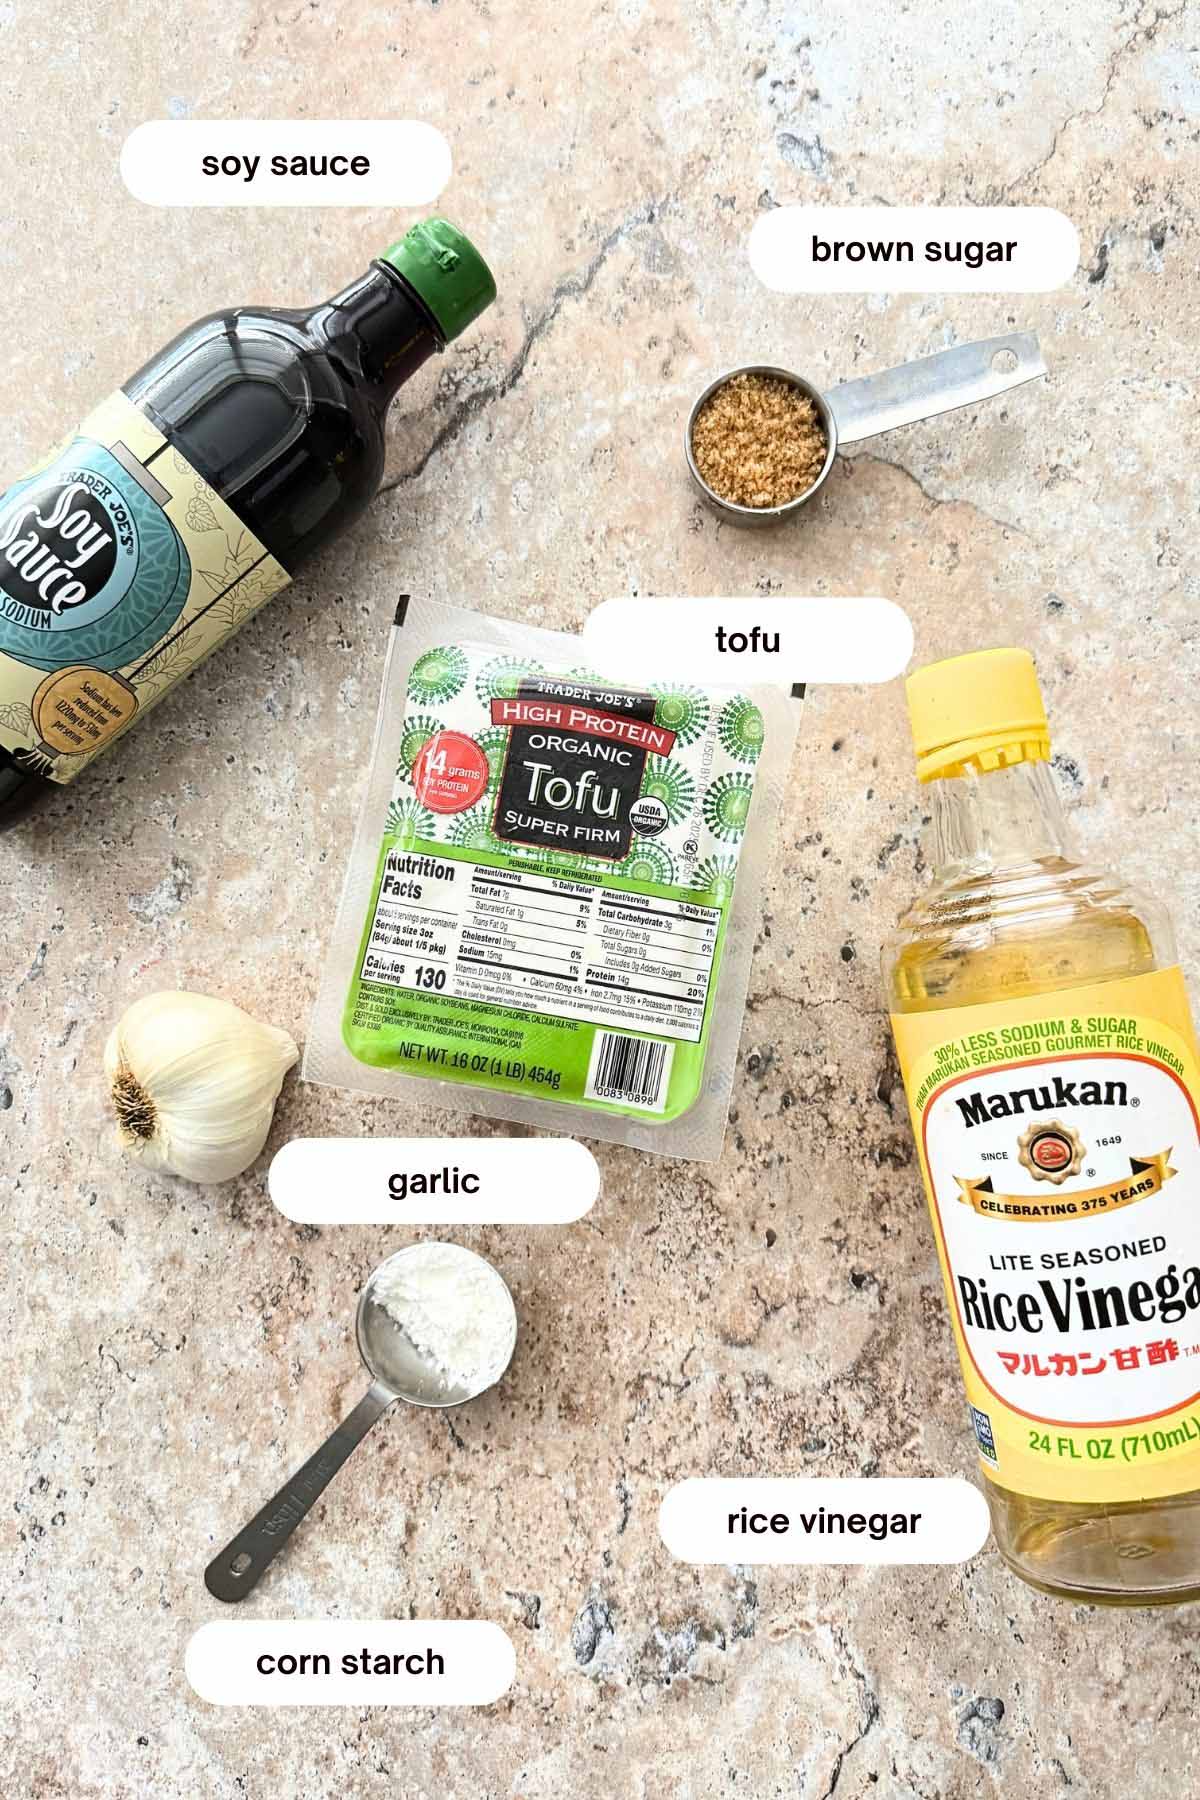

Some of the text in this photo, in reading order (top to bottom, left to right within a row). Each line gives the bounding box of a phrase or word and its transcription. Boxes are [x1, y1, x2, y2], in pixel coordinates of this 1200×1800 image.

[36, 481, 113, 569] Soy
[0, 503, 87, 616] Sauce
[0, 597, 51, 629] SODIUM
[538, 682, 591, 701] TRADER
[503, 702, 665, 748] HIGH PROTEIN
[528, 734, 633, 766] ORGANIC
[424, 749, 481, 780] 14 grams
[437, 779, 470, 793] PROTEIN
[523, 760, 621, 819] Tofu
[638, 804, 661, 817] USDA
[504, 810, 621, 843] SUPER FIRM
[385, 850, 456, 881] Nutrition
[473, 866, 522, 882] Amount/serving
[381, 874, 423, 899] Facts
[470, 883, 488, 894] Total
[489, 887, 500, 896] Fat
[558, 881, 574, 891] Daily
[475, 900, 504, 913] Saturated
[505, 906, 515, 915] Fat
[601, 890, 649, 906] Amount/serving
[578, 904, 590, 913] 9%
[597, 907, 615, 918] Total
[616, 911, 663, 928] Carbohydrate
[685, 905, 699, 915] Daily
[374, 919, 434, 938] Serving size 3oz
[472, 916, 508, 932] Trans Fat 0g
[575, 919, 587, 928] 5%
[602, 924, 625, 937] Dietary
[625, 928, 641, 939] Fiber
[392, 935, 413, 947] about
[414, 939, 427, 950] 1/5
[428, 941, 446, 955] pkg)
[461, 930, 516, 949] Cholesterol 0mg
[600, 939, 615, 949] Total
[615, 942, 638, 955] Sugars
[701, 943, 712, 952] 0%
[458, 944, 502, 961] Sodium 15mg
[570, 950, 582, 959] 0%
[363, 968, 401, 983] per serving
[568, 965, 579, 974] 1%
[585, 968, 629, 985] Protein 14g
[604, 956, 630, 968] Includes
[640, 962, 660, 973] Added
[660, 966, 682, 979] Sugars
[413, 965, 447, 990] 130
[455, 963, 477, 974] Vitamin
[529, 976, 554, 989] Calcium
[590, 988, 603, 998] Iron
[641, 998, 672, 1011] Potassium
[686, 987, 705, 998] 20%
[934, 1017, 1137, 1065] 30% LESS SODIUM & SUGAR
[399, 1041, 561, 1090] NET WT. 16 OZ (1 LB) 454g
[915, 1034, 1185, 1112] THAN MARUKAN SEASONED GOURMET RICE VINEGAR
[596, 1085, 655, 1106] 0083 0898
[1096, 1135, 1122, 1148] 1649
[980, 1151, 1009, 1161] SINCE
[980, 1178, 1155, 1216] CELEBRATING 375 YEARS
[989, 1235, 1166, 1271] LITE SEASONED
[957, 1274, 1044, 1333] Rice
[996, 1337, 1180, 1377] マルカン甘酢
[1029, 1416, 1200, 1462] 24 FL OZ (710mL)
